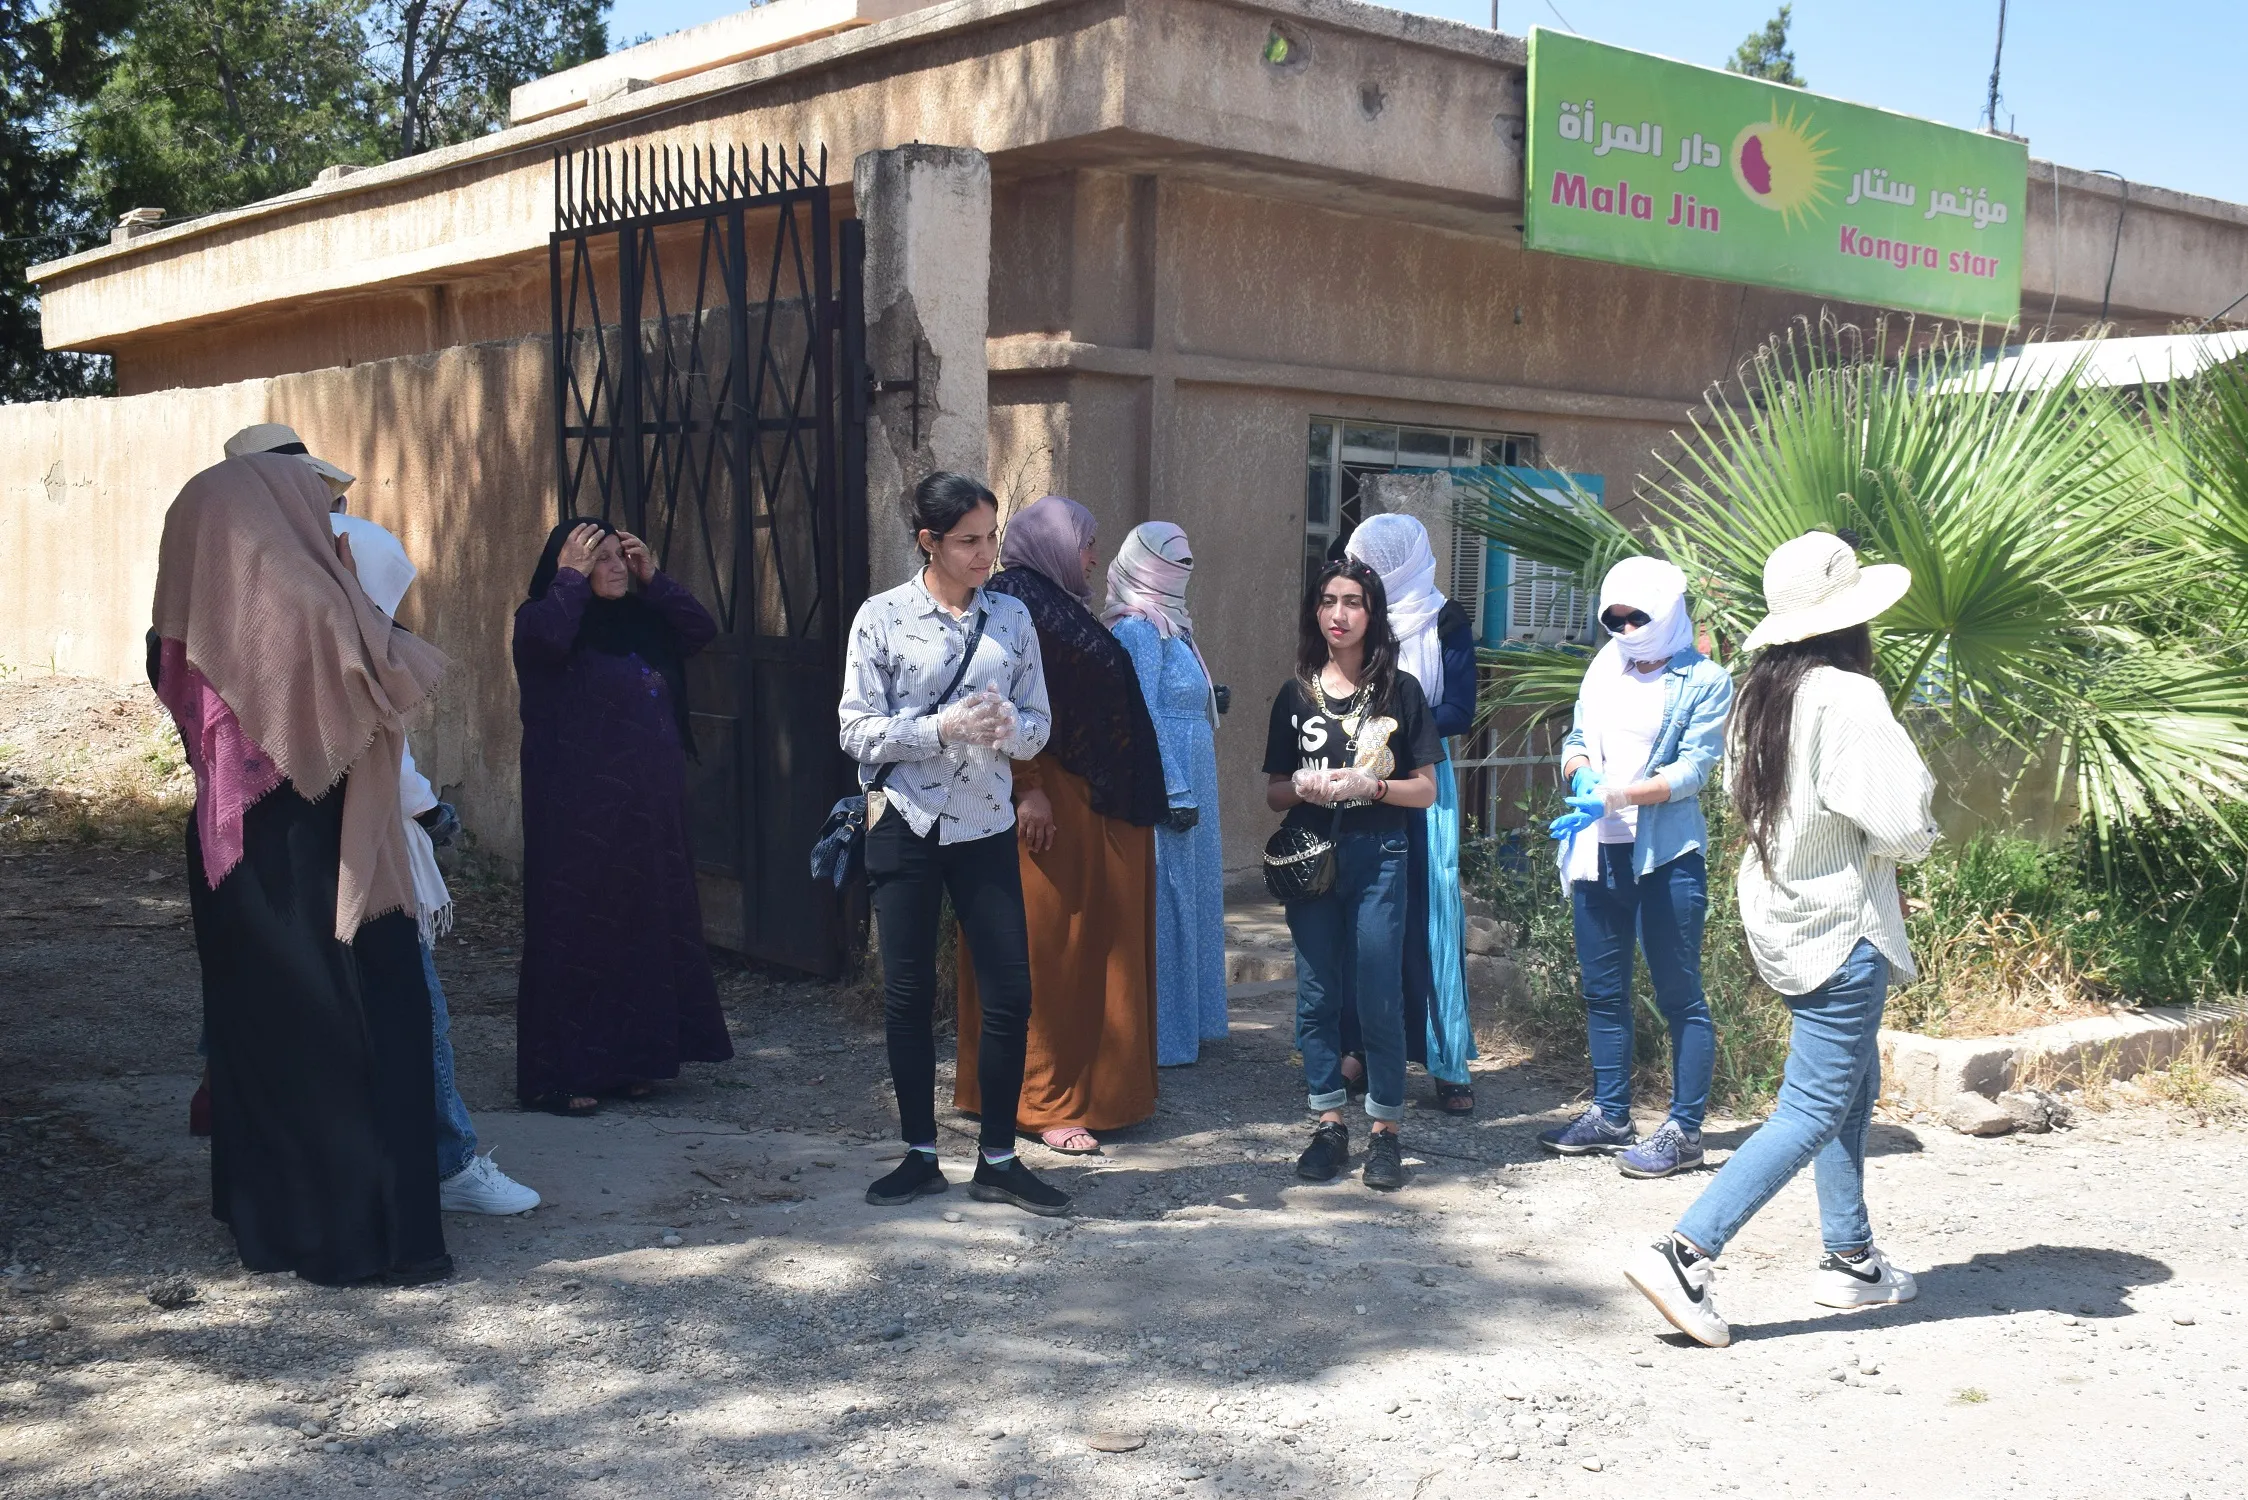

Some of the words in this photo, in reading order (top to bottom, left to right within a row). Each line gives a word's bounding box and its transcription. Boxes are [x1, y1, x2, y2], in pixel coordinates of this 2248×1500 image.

[1558, 99, 1662, 157] المرأة
[1672, 132, 1721, 172] دار
[1551, 171, 1652, 220] Mala
[1667, 192, 1720, 232] Jin
[1845, 168, 1916, 206] ستار
[1924, 186, 2008, 230] مؤتمر
[1840, 225, 1938, 269] Kongra
[1948, 250, 1999, 278] star
